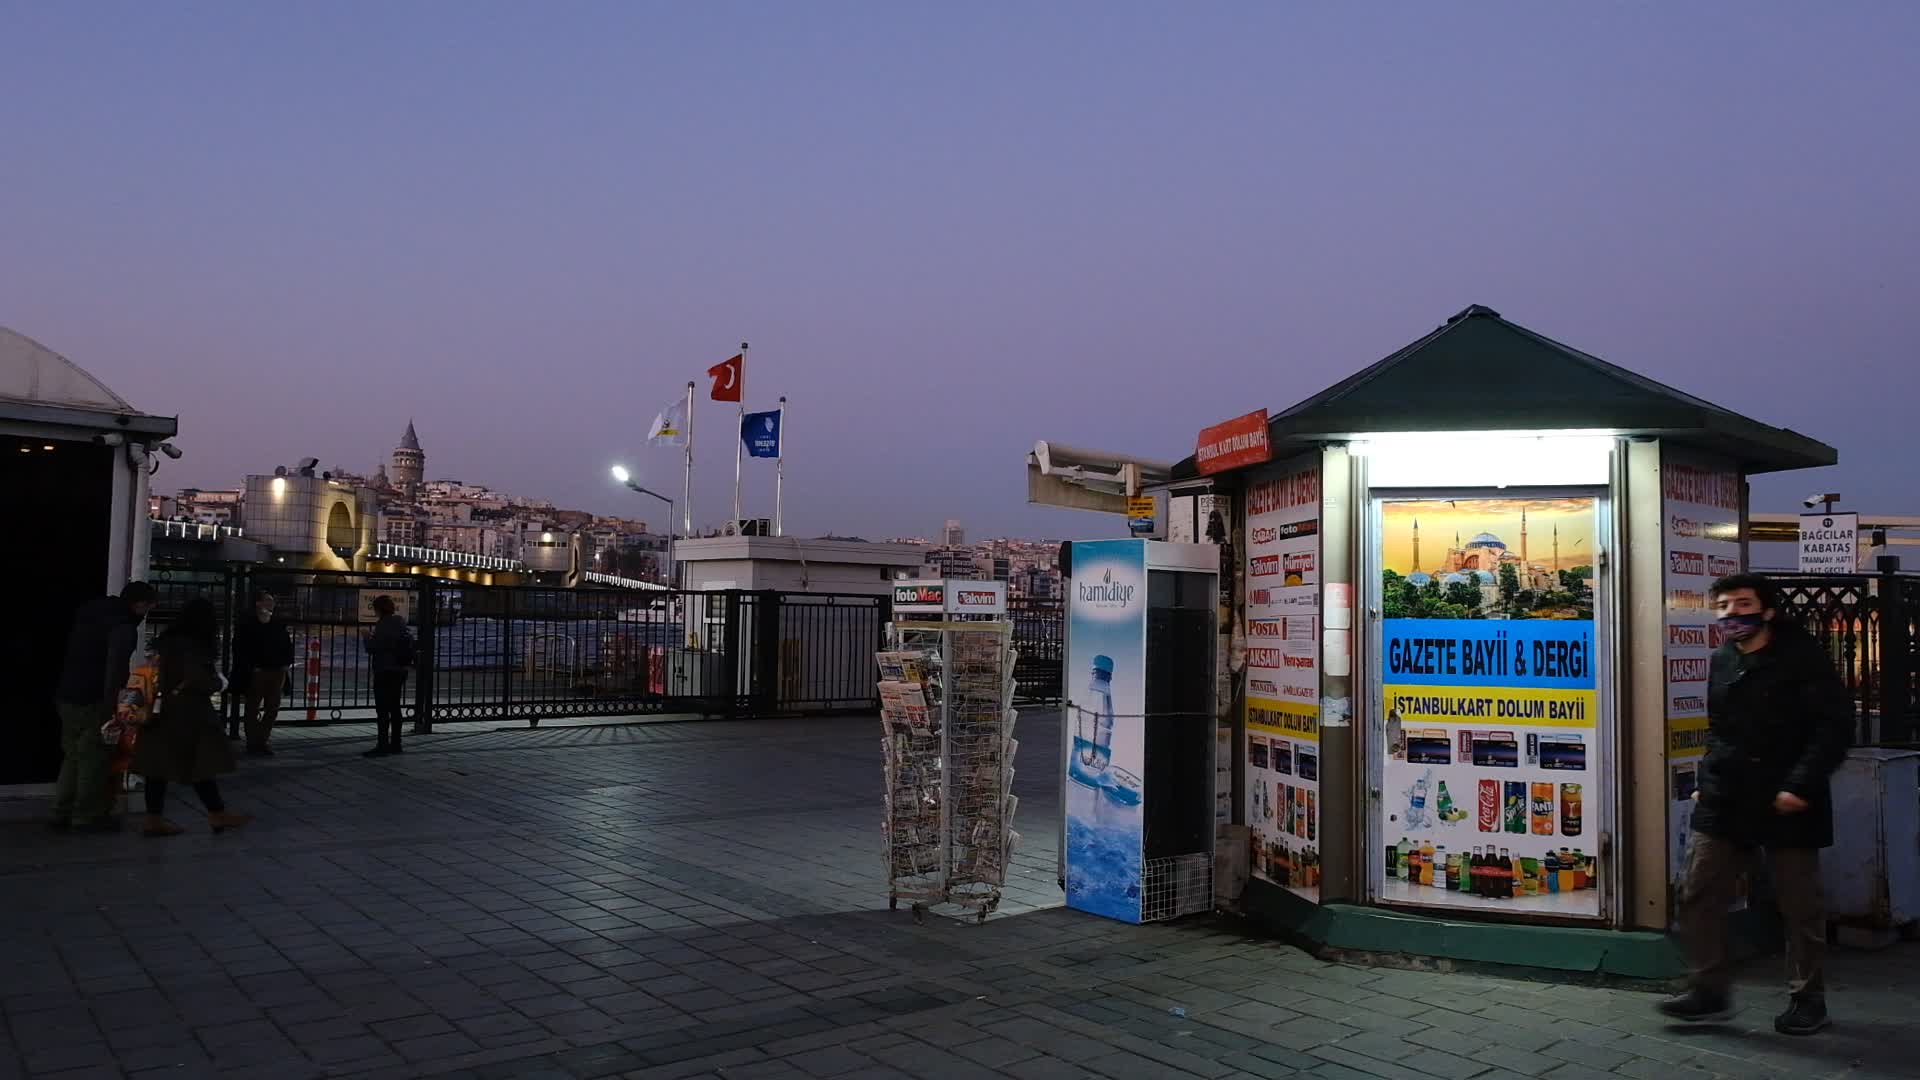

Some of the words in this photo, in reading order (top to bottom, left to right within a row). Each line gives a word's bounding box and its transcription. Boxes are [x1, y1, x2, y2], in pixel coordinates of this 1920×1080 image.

[1804, 543, 1850, 555] KABATAŞ
[1079, 581, 1135, 608] hamidiye
[1248, 619, 1279, 637] POSTA
[1670, 625, 1705, 645] POSTA
[1390, 638, 1457, 675] GAZETE
[1462, 630, 1508, 677] BAYİİ
[1514, 639, 1526, 677] &
[1533, 631, 1588, 678] DERGİ
[1497, 697, 1544, 719] DOLUM
[1549, 696, 1585, 721] BAYİİ
